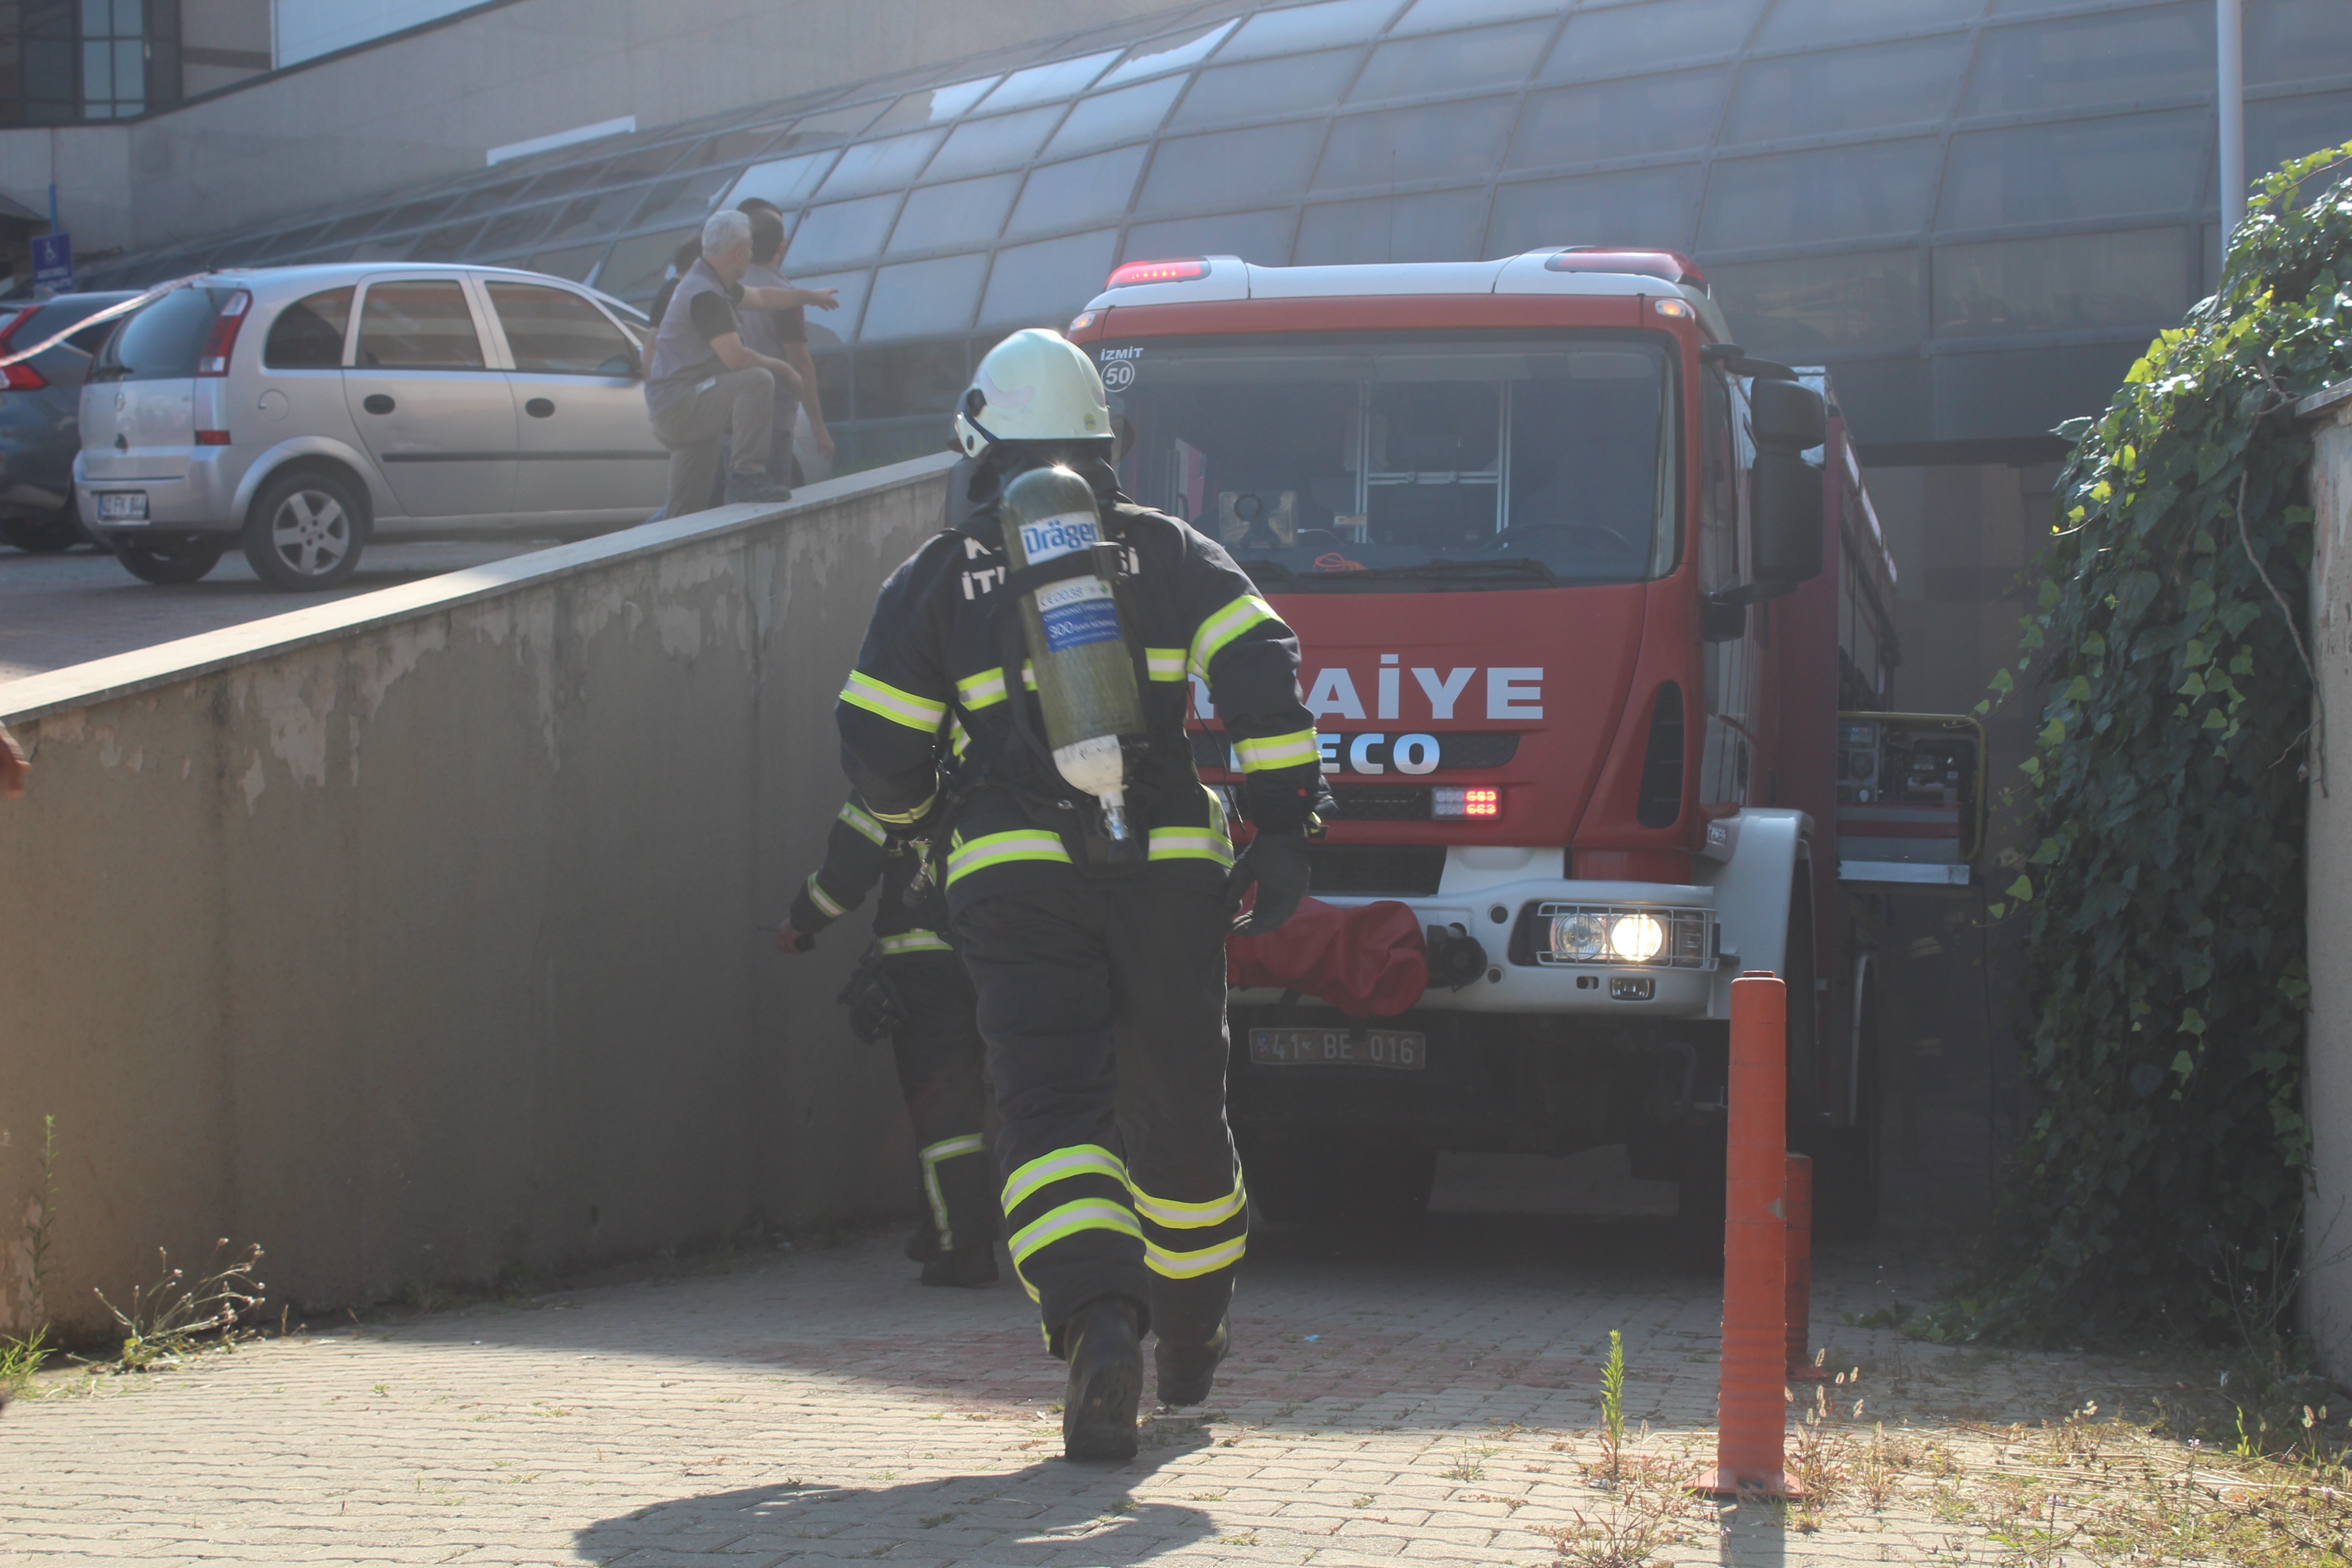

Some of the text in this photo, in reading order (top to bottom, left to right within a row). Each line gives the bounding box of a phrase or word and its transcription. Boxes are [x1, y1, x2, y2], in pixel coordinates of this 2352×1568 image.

[1100, 346, 1143, 361] İZMİT
[1106, 367, 1131, 385] 50
[1023, 520, 1098, 554] Dräger
[1272, 1034, 1414, 1064] 41 BE 016
